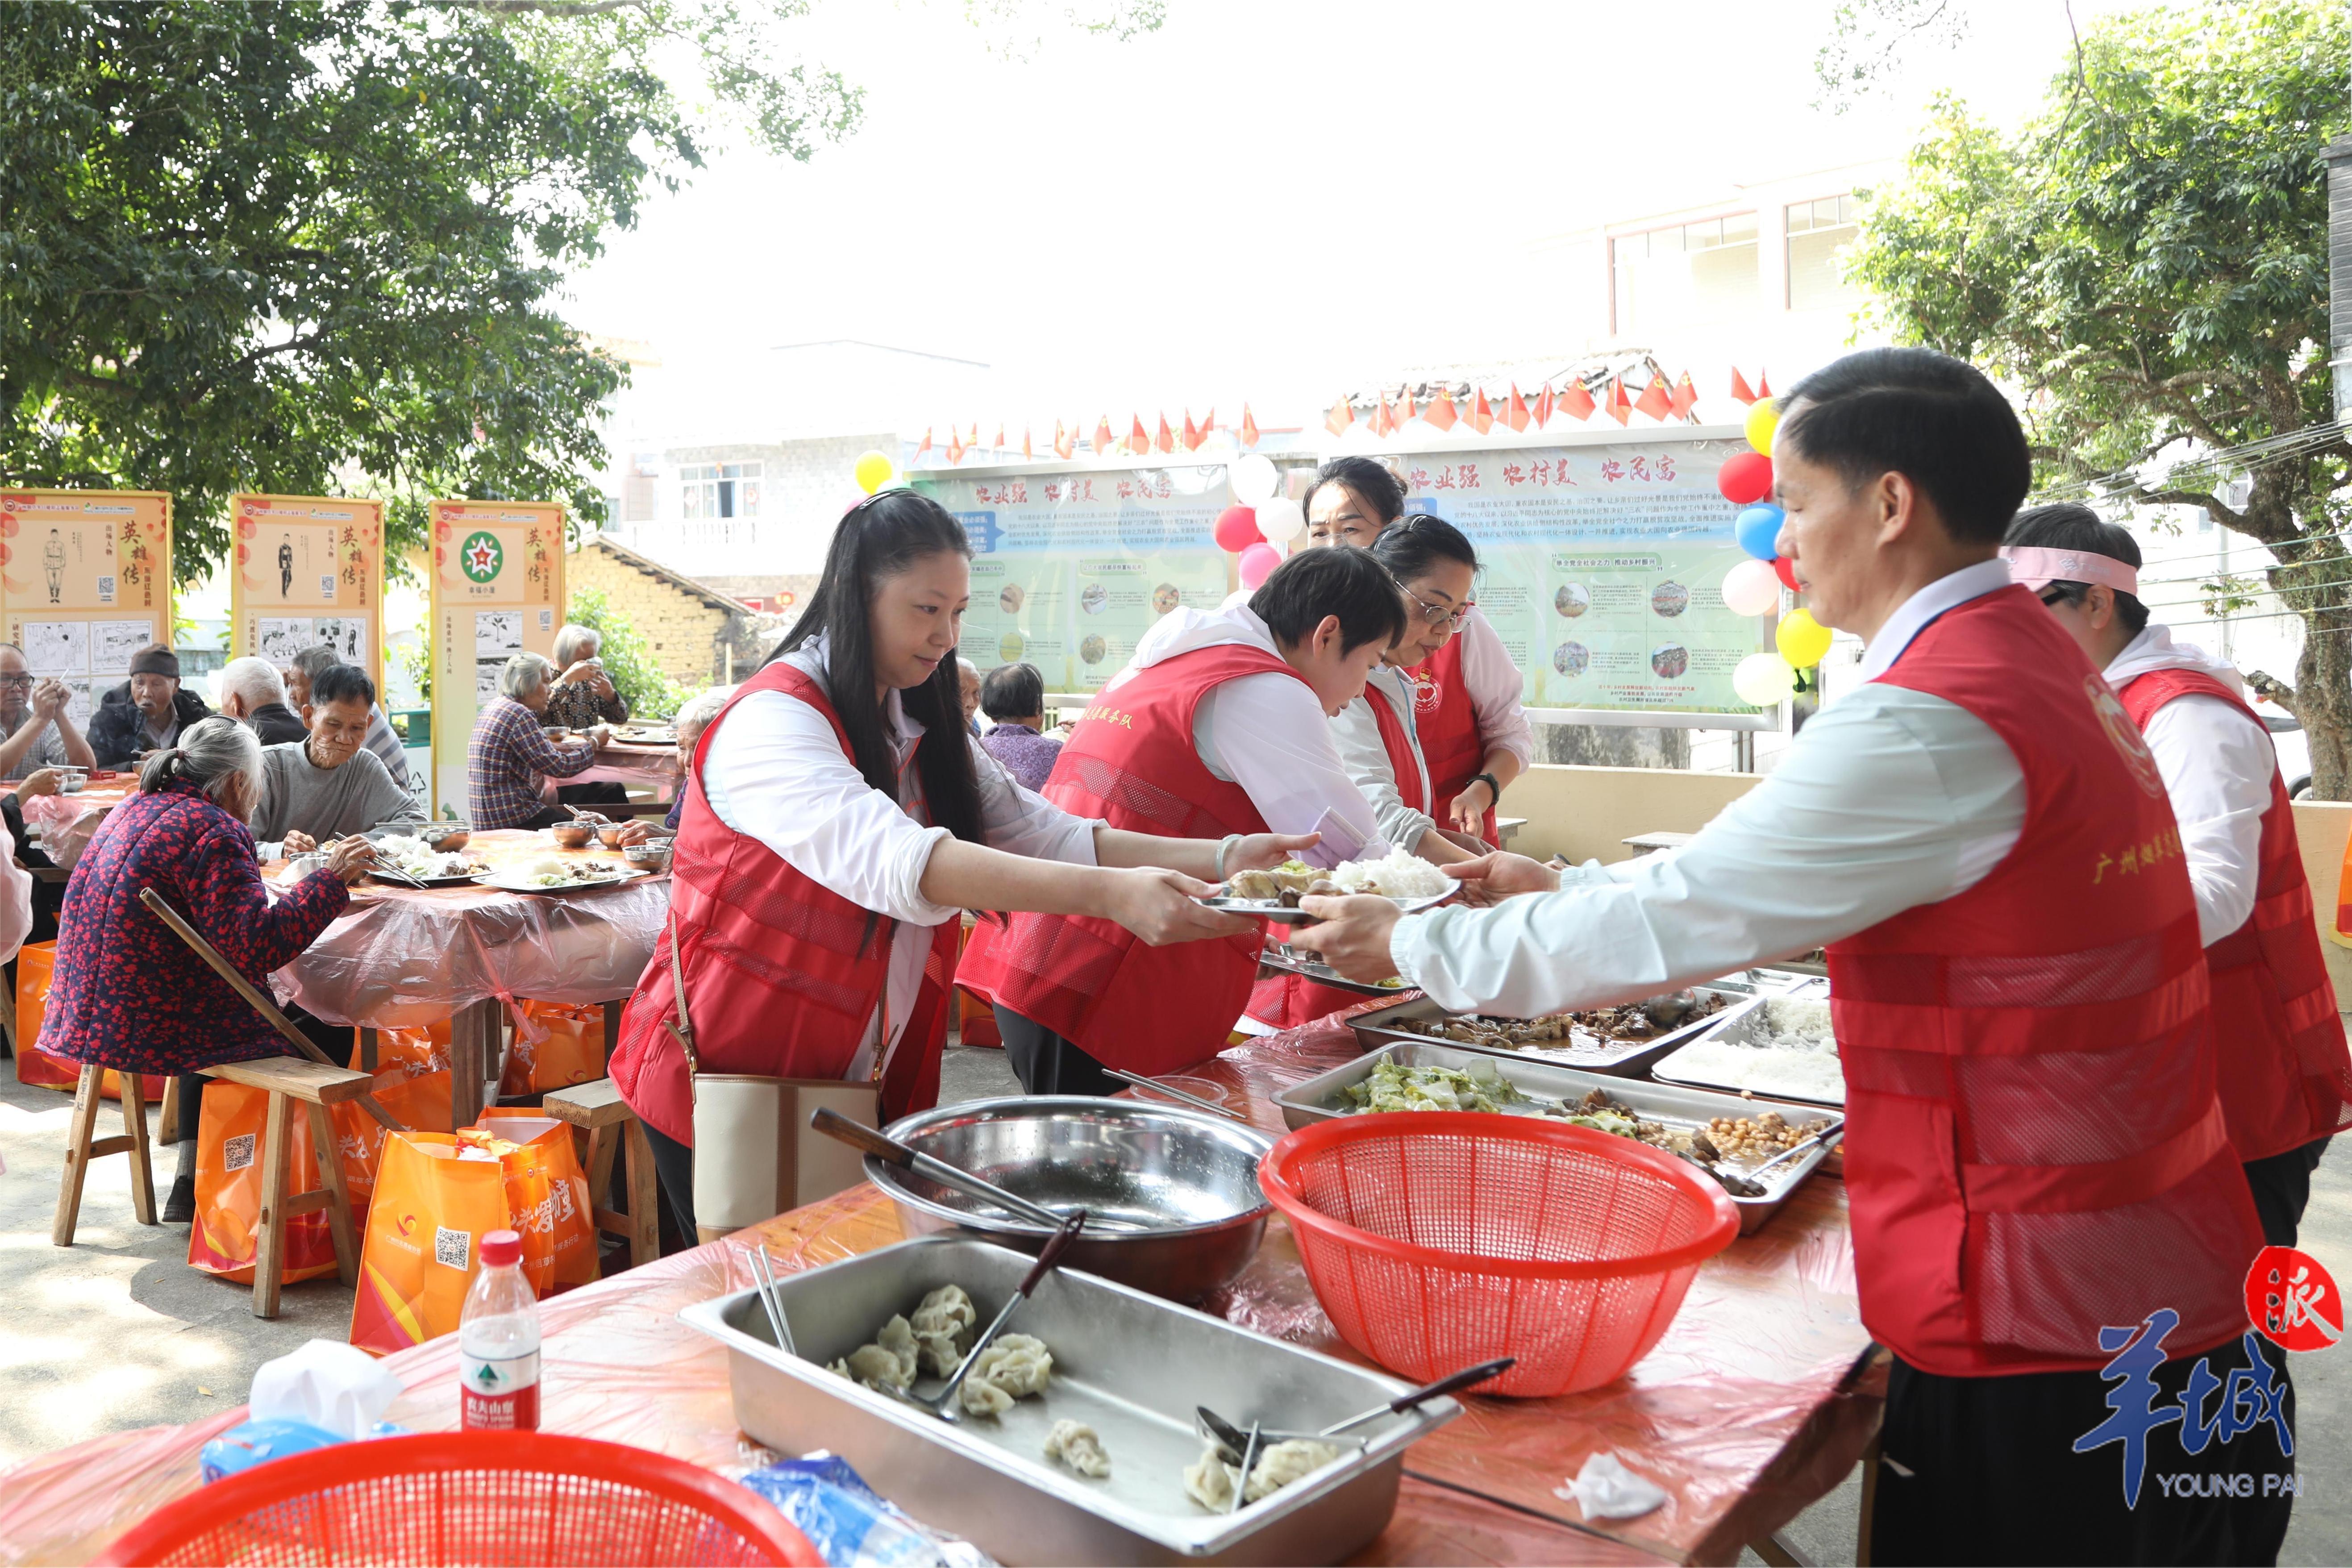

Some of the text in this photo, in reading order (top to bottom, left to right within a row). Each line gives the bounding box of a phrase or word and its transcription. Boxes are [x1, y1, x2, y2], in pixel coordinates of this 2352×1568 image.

[975, 482, 1028, 505] 农业强
[1117, 475, 1172, 499] 农民富
[1409, 453, 1677, 491] 农业强 农村美 农民富
[120, 520, 148, 585] 英雄传
[340, 525, 363, 585] 英雄传
[526, 527, 547, 582] 英雄传
[469, 586, 495, 594] 幸福小屋
